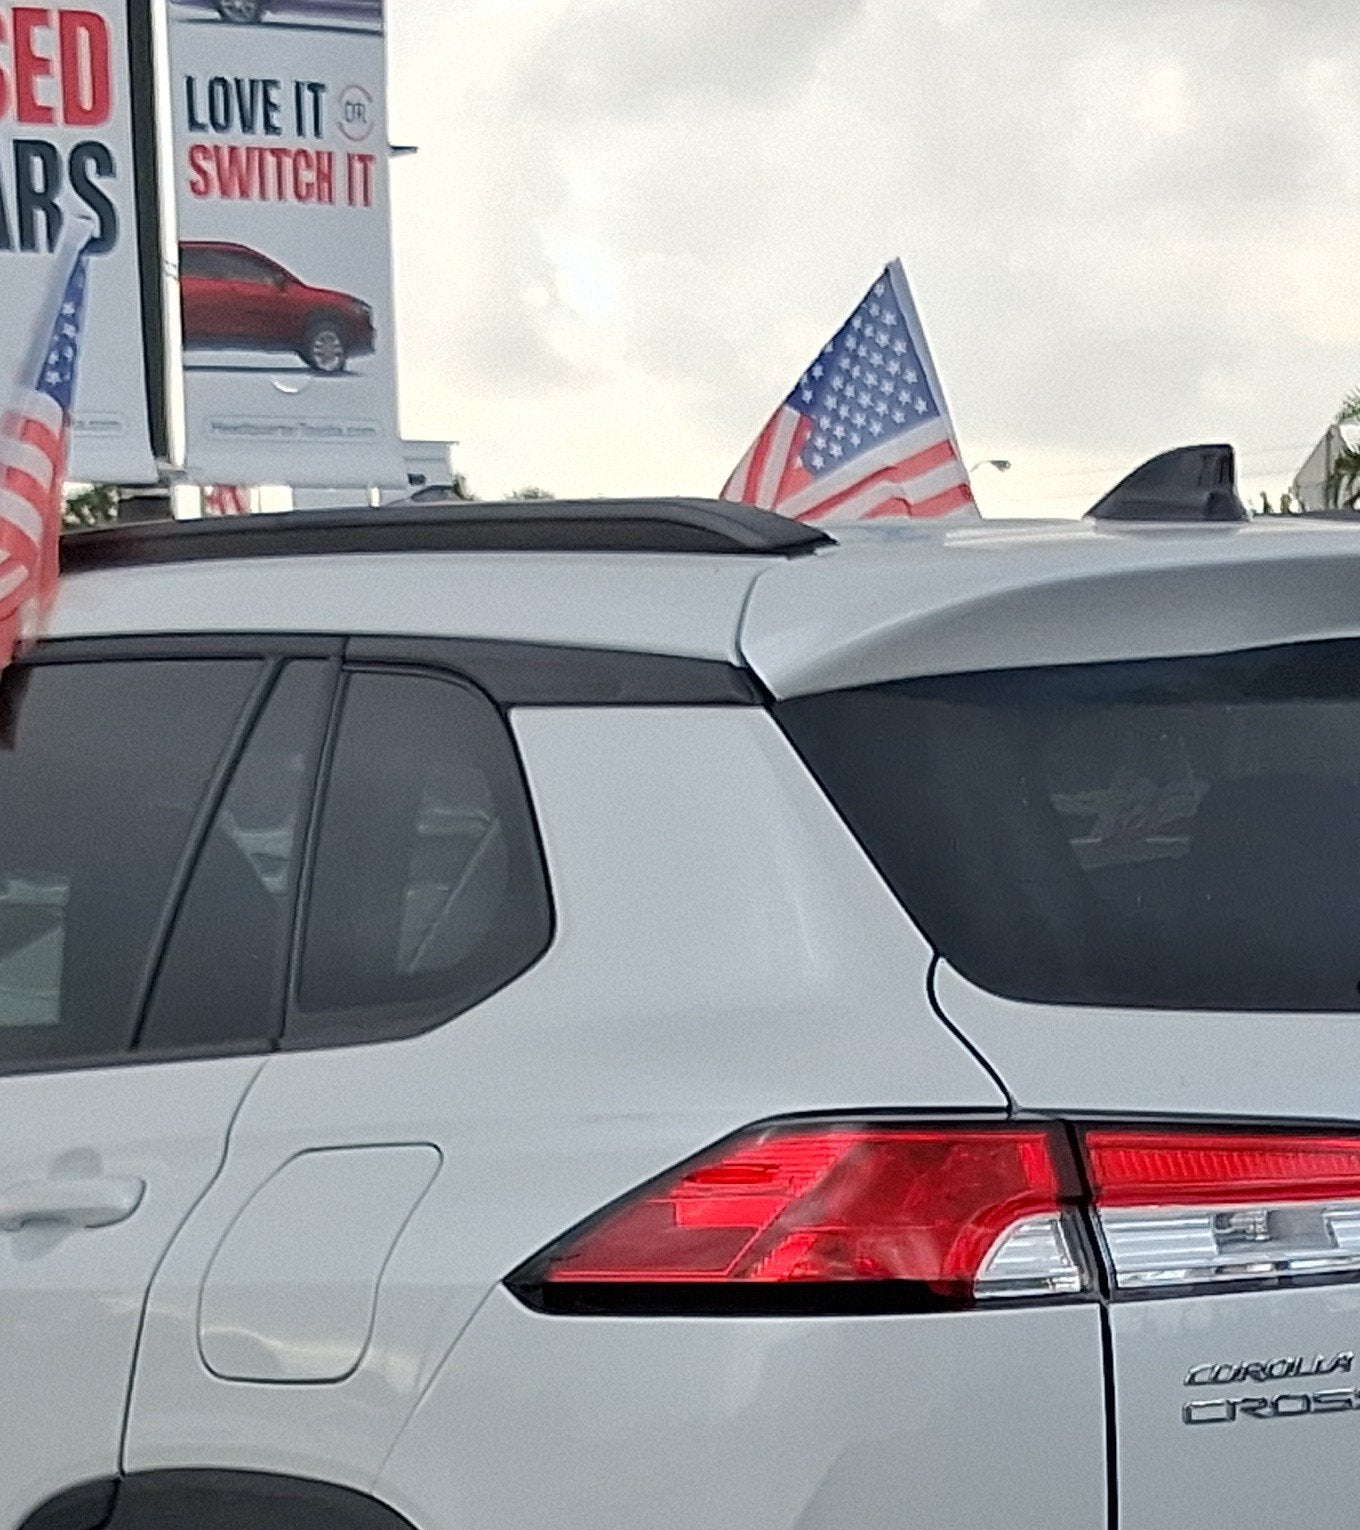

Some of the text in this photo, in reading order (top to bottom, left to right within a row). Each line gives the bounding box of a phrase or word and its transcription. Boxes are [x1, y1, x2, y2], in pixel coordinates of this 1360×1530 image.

[184, 74, 367, 139] LOVE IT OR
[189, 143, 376, 207] SWITCH IT
[1183, 1350, 1355, 1386] COROLLA
